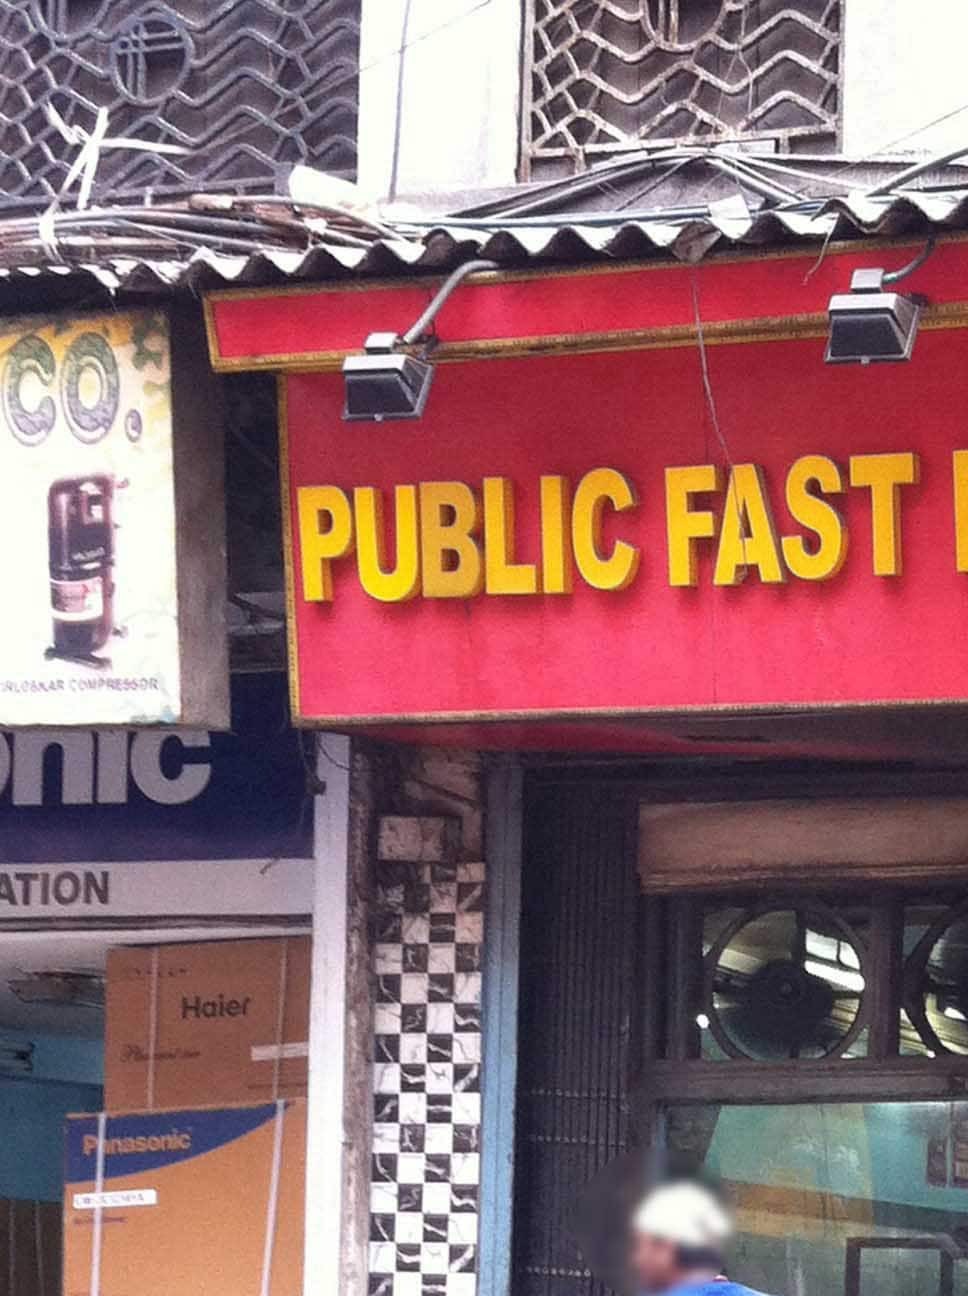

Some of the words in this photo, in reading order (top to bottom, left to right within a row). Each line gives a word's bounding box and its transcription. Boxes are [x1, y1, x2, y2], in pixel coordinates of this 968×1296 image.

[1, 331, 142, 447] CO.
[297, 466, 641, 603] PUBLIC
[665, 450, 920, 588] FAST
[0, 730, 211, 805] nic
[181, 994, 251, 1018] Haier
